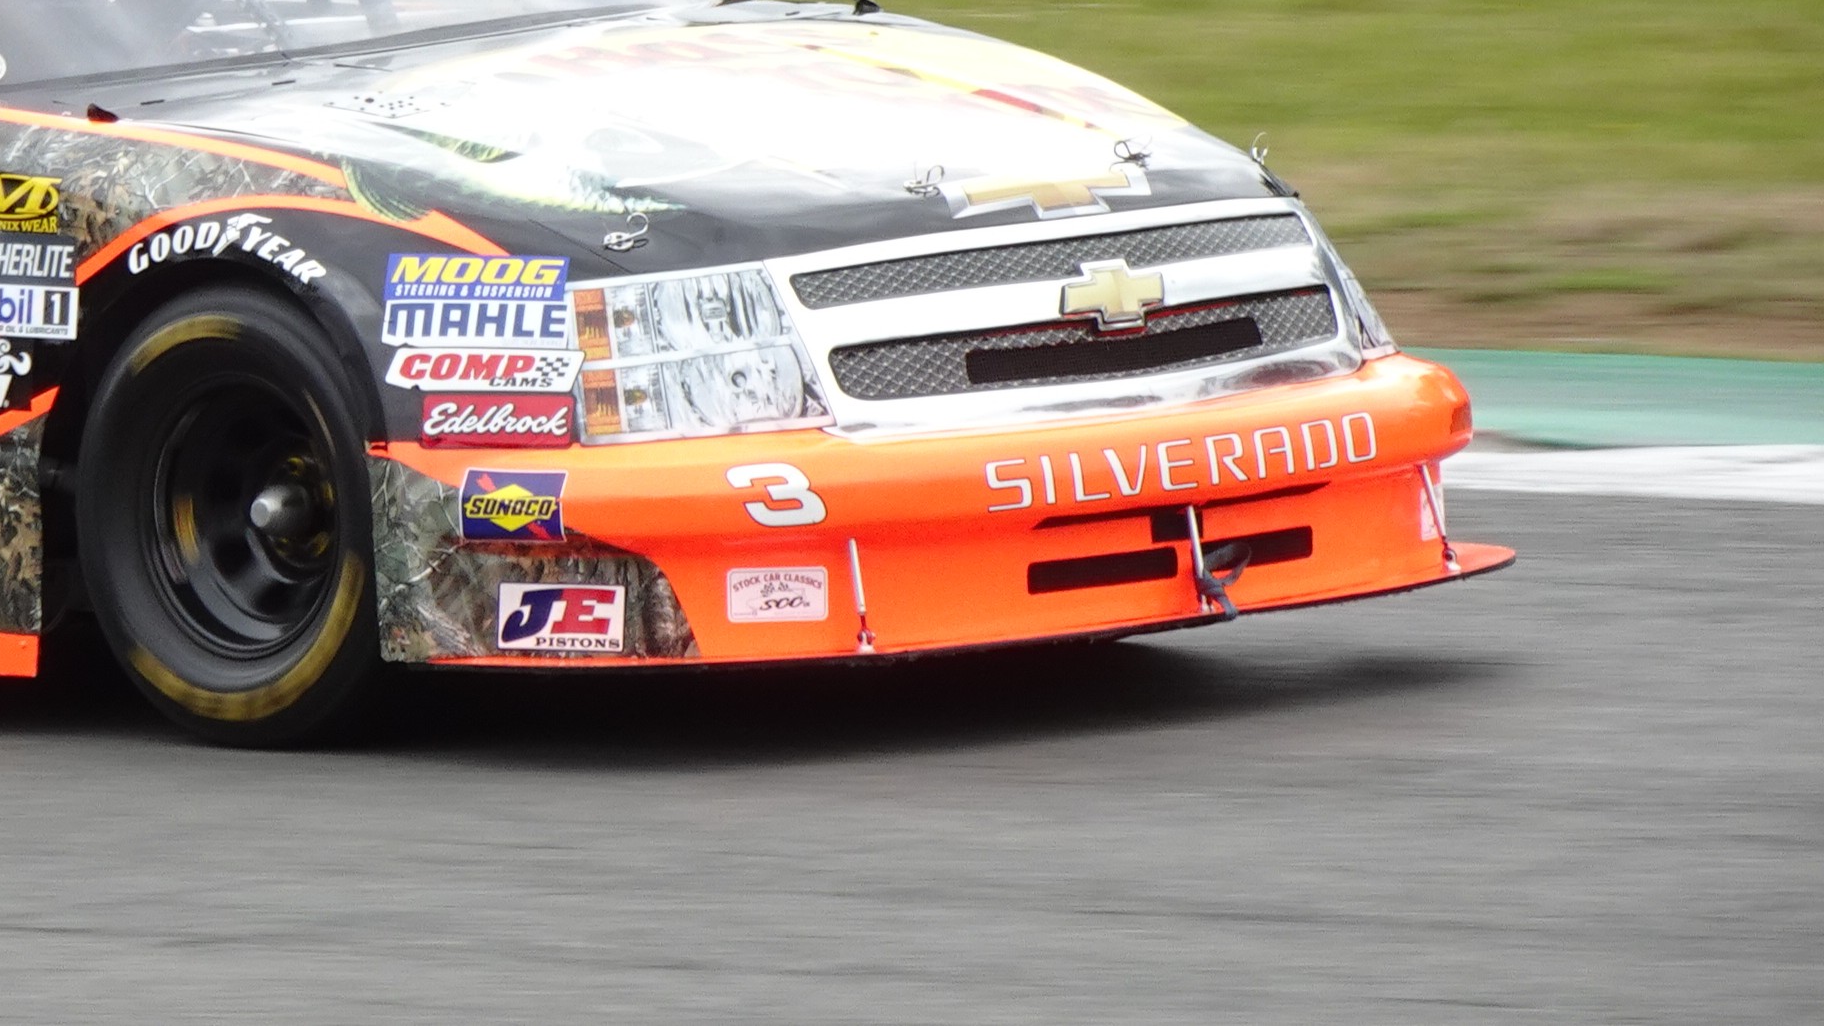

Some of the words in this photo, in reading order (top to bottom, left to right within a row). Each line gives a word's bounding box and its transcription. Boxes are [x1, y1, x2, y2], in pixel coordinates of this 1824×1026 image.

[21, 216, 59, 234] WEAR
[391, 256, 564, 285] MOOG
[395, 284, 455, 297] STEERING
[460, 285, 468, 297] &
[474, 285, 552, 298] SUSPENSION
[48, 292, 64, 324] 1
[387, 302, 567, 338] MAHLE
[5, 325, 15, 333] OIL
[26, 326, 69, 335] LUBRICANTS
[399, 354, 536, 380] COMP
[489, 376, 553, 387] CAMS
[423, 402, 569, 436] Edelbrock
[985, 412, 1376, 513] SILVERADO
[469, 498, 554, 516] SUNOCO
[726, 462, 828, 527] 3
[733, 575, 761, 592] STOCK
[764, 573, 780, 582] CAR
[784, 574, 823, 590] CLASSICS
[501, 587, 616, 643] JE
[535, 635, 620, 649] PISTONS
